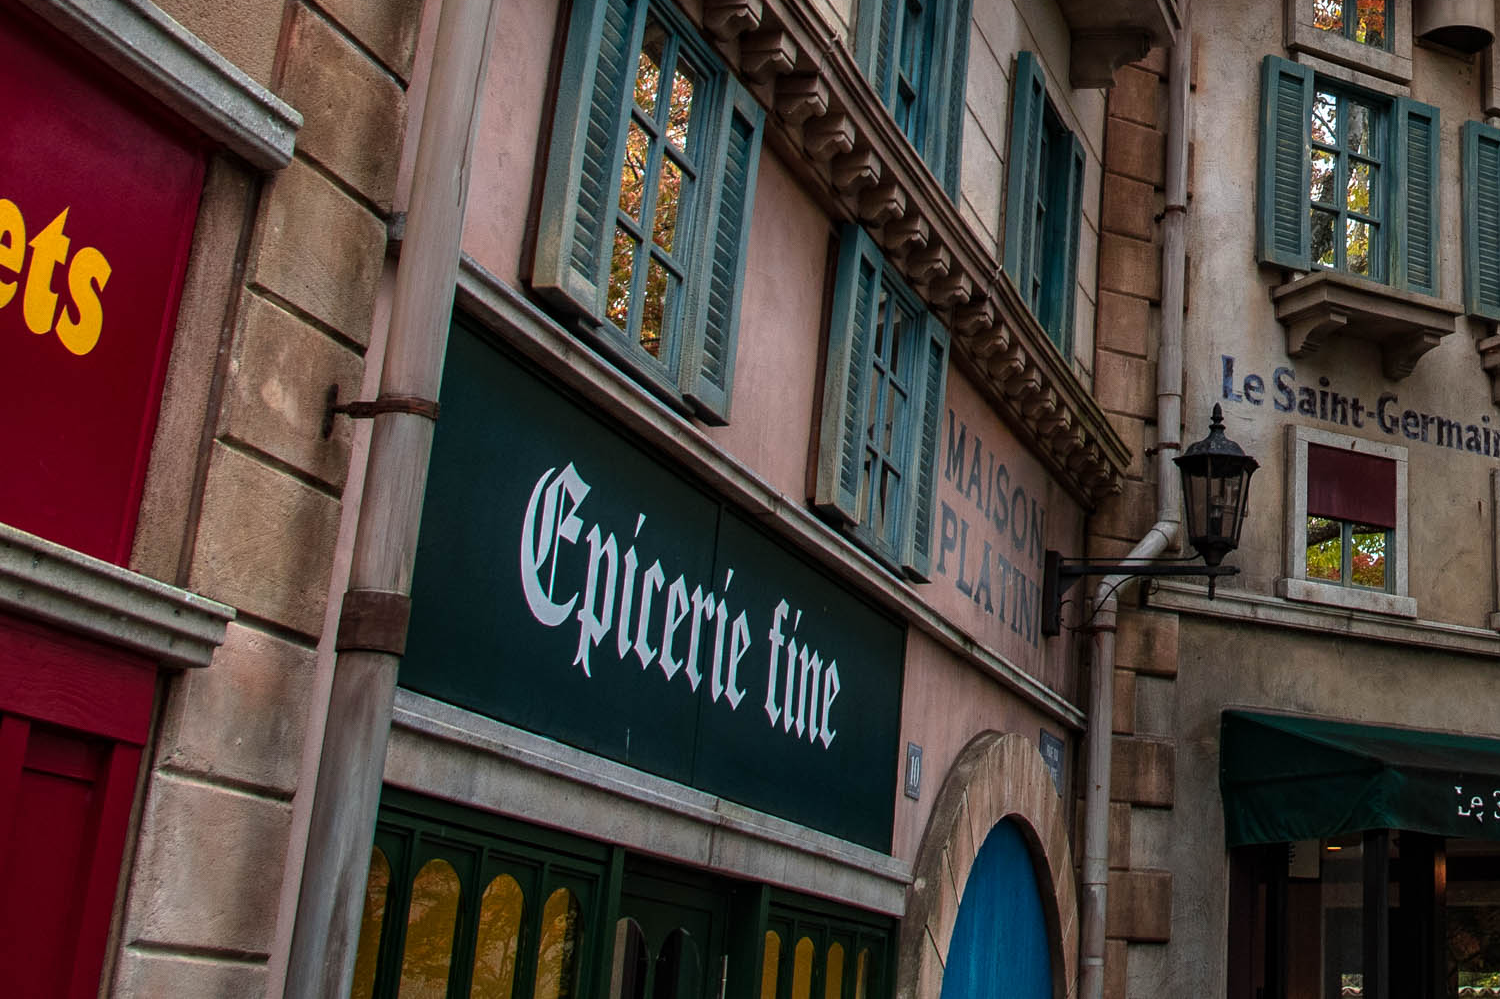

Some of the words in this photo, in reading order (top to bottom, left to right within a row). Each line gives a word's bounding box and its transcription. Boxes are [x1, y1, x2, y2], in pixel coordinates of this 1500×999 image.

[1221, 354, 1265, 406] Le
[944, 408, 1046, 571] MAISON
[520, 461, 751, 712] Epicerie
[764, 598, 841, 751] fine
[909, 755, 921, 789] 10
